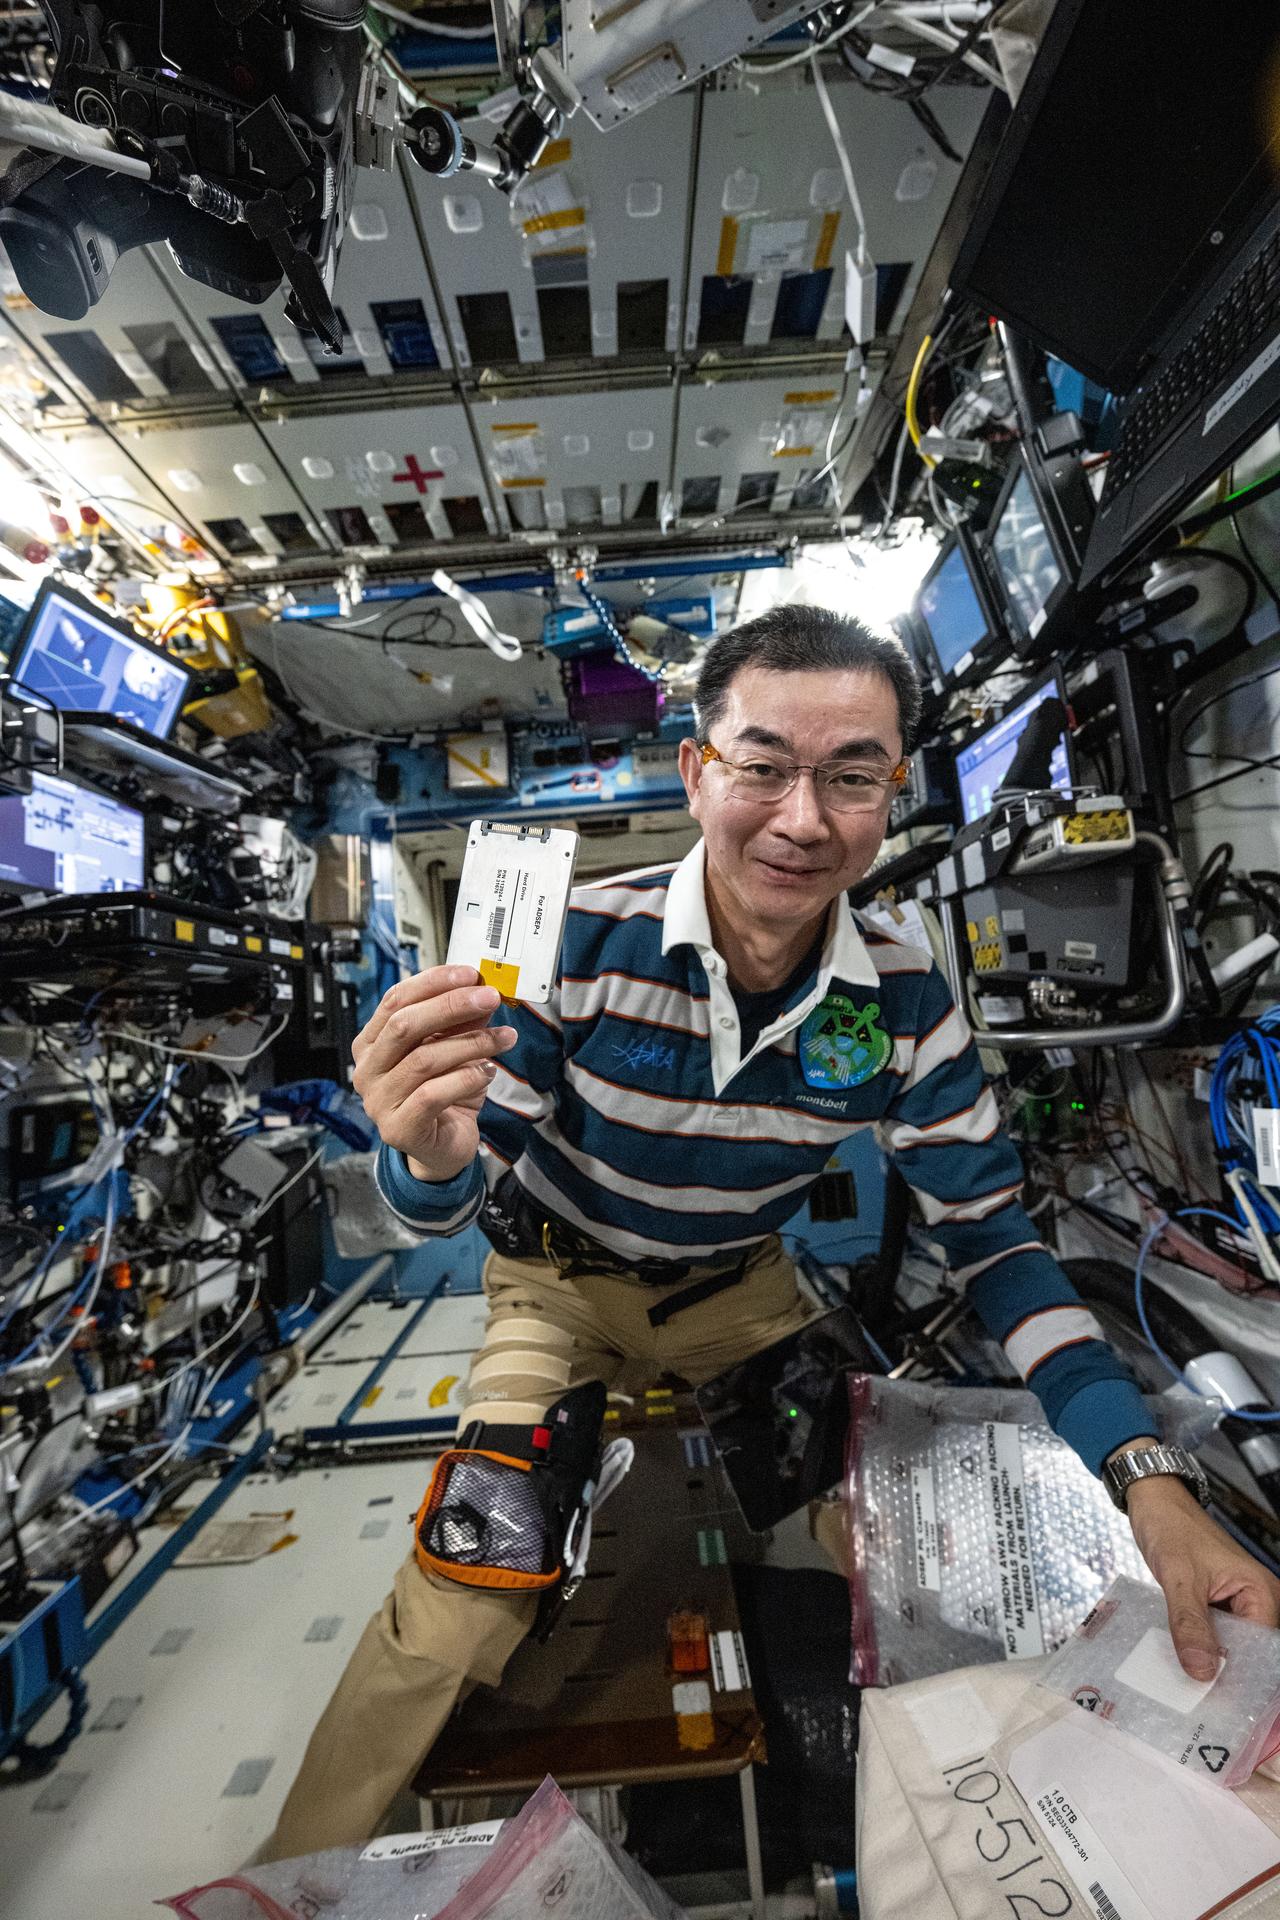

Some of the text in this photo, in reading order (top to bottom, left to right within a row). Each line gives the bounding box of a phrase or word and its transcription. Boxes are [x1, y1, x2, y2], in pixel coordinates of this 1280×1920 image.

[533, 907, 543, 935] ADSEP-4
[986, 1423, 1017, 1654] NOT THROW AWAY PACKING PACKING
[1006, 1519, 1016, 1555] FROM
[1018, 1535, 1029, 1561] FOR
[917, 1555, 927, 1587] ADSEP
[1009, 1560, 1025, 1629] MATERIALS
[1022, 1564, 1034, 1613] NEEDED
[1186, 1742, 1195, 1757] NO.
[1036, 1799, 1056, 1828] S/N 5124
[1043, 1794, 1054, 1807] P/N
[1051, 1789, 1078, 1825] 1.0 CTB
[390, 1840, 436, 1856] Cassette
[458, 1833, 494, 1843] ADSEP
